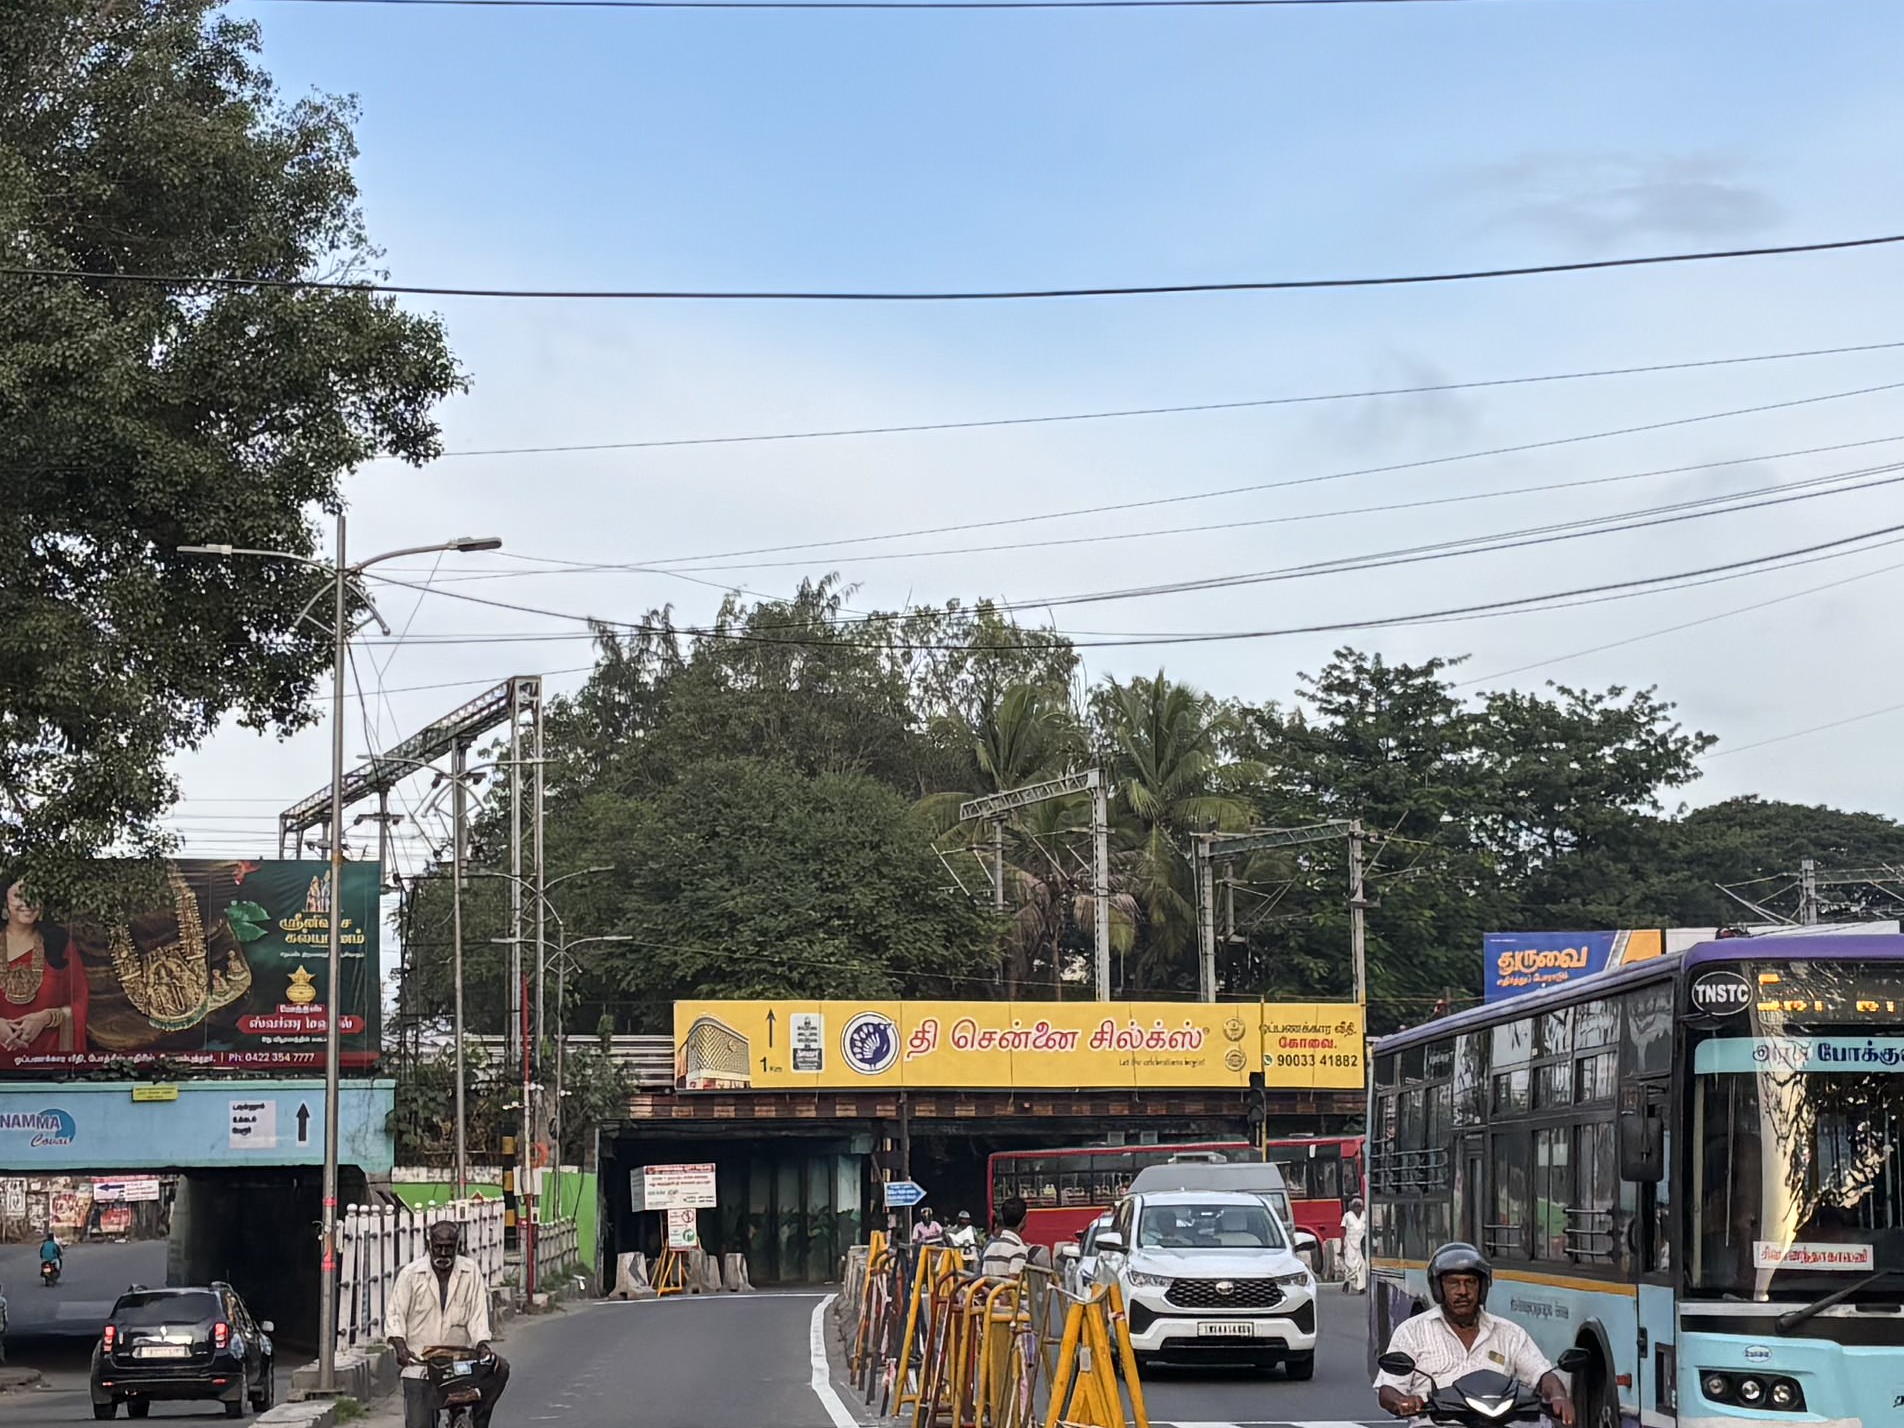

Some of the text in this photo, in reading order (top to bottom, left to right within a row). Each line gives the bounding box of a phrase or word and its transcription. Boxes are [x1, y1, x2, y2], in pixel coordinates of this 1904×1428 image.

[279, 913, 352, 932] ஸ்ரீனிவச
[1498, 946, 1588, 975] துருவை
[1696, 984, 1748, 1003] TNSTC
[905, 1018, 1204, 1059] தி சென்னை சில்க்ஸ்
[1279, 1037, 1338, 1049] கோவை.
[245, 1053, 270, 1062] 0422
[272, 1053, 291, 1062] 354
[293, 1053, 315, 1062] 7777
[760, 1057, 768, 1072] 1
[1278, 1054, 1358, 1067] 90033 41882
[0, 1113, 62, 1130] NAMMA
